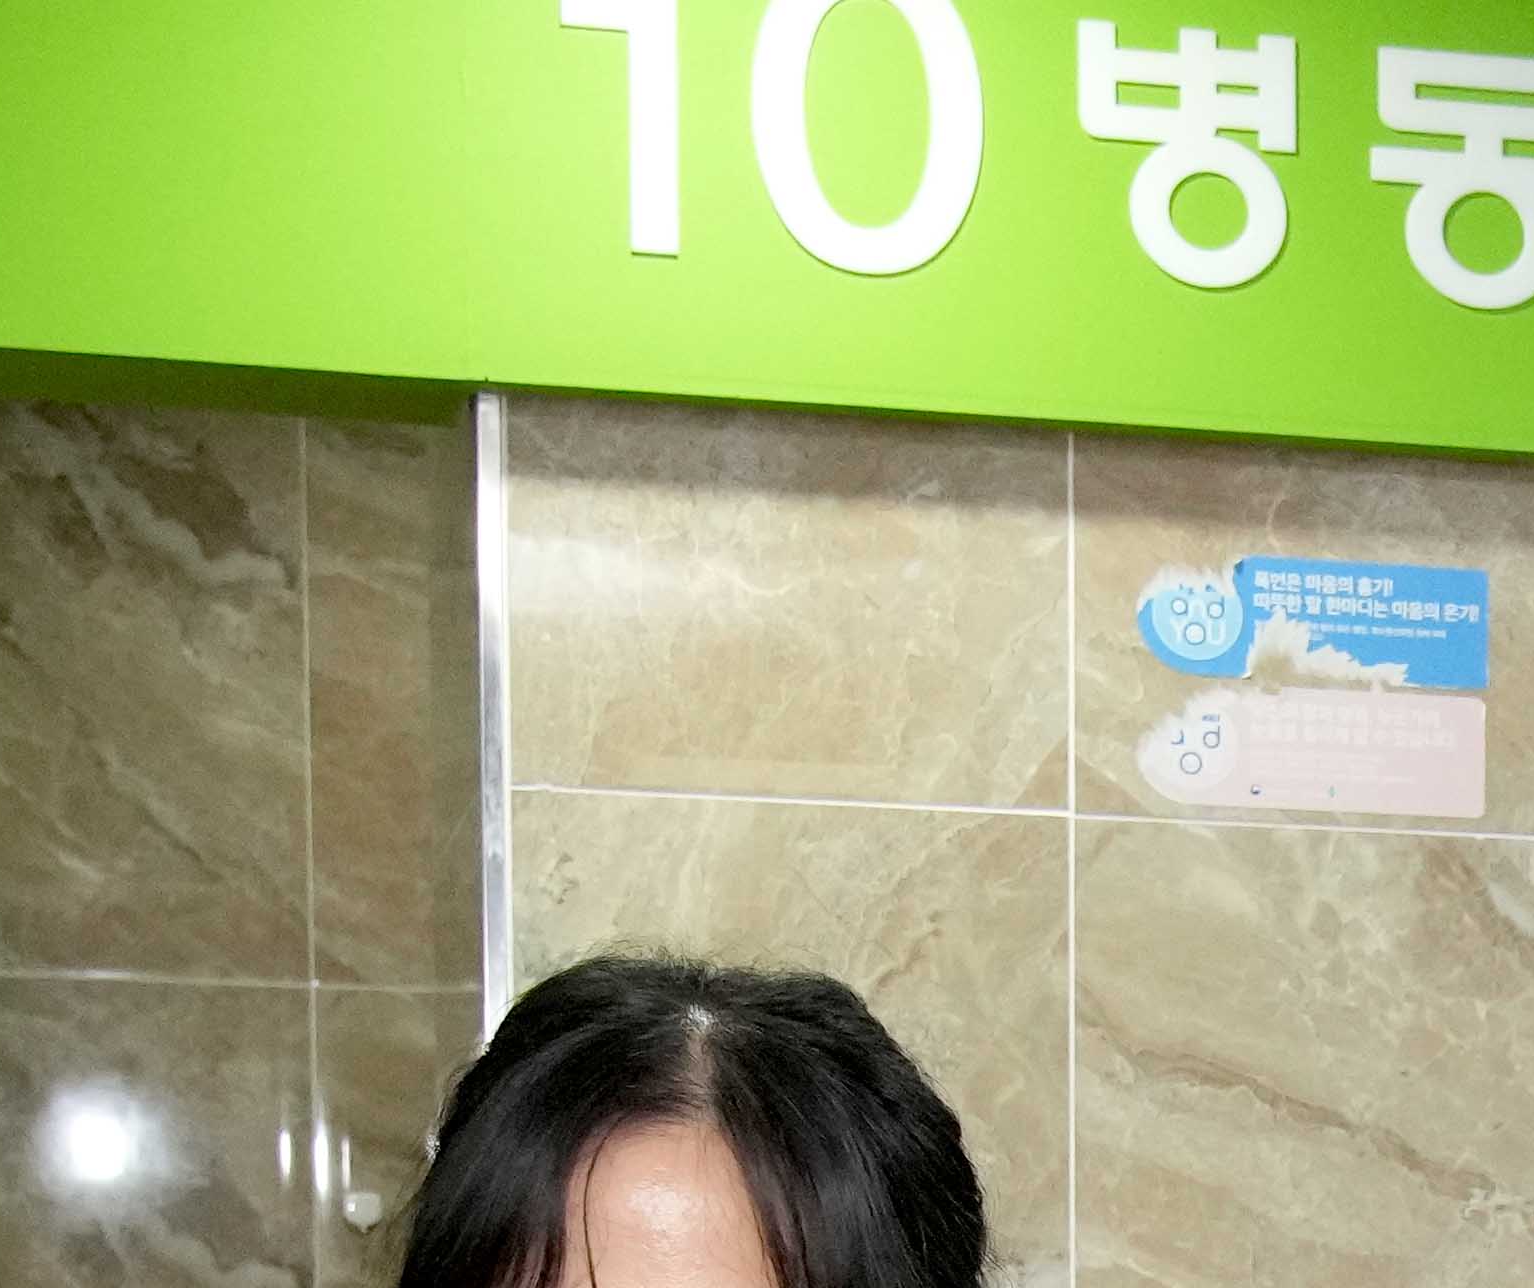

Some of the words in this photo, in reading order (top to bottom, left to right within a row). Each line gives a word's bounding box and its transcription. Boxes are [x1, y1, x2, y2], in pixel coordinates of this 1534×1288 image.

[559, 0, 984, 276] 10
[1305, 572, 1354, 595] 마음의
[1394, 600, 1440, 621] 마음의
